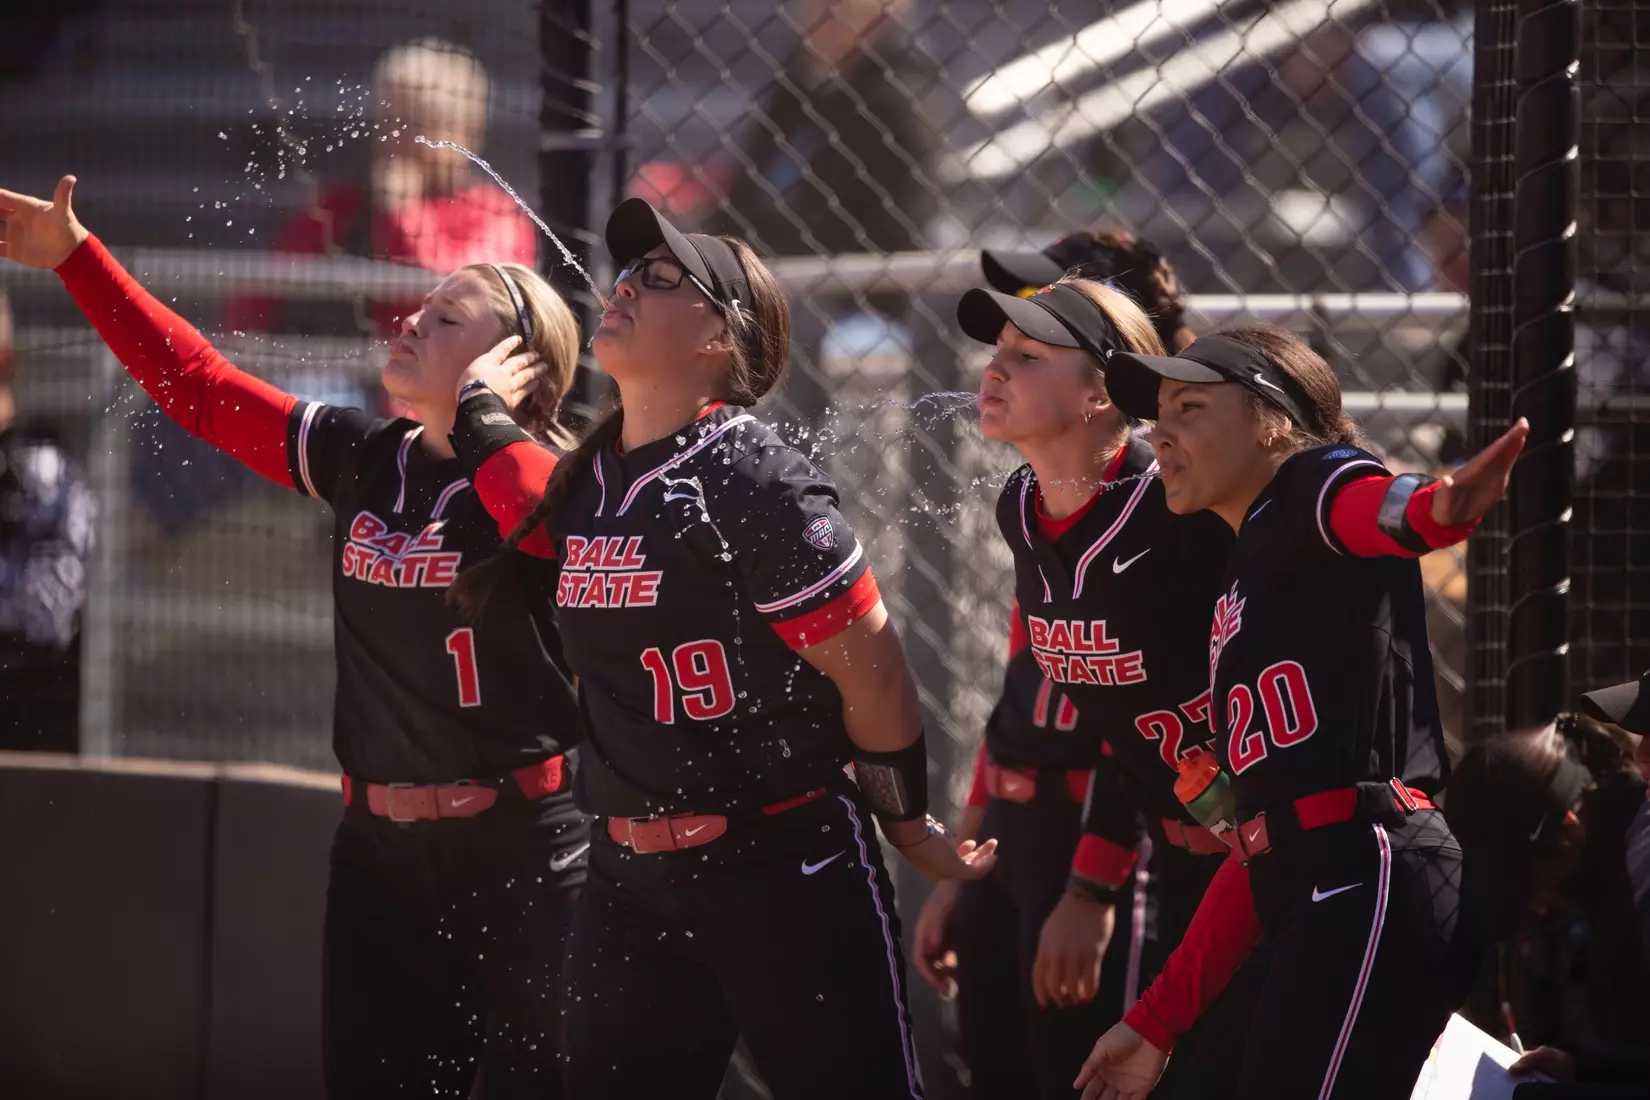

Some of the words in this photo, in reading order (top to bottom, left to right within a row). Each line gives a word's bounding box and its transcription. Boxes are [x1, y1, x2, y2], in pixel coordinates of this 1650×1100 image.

[343, 541, 463, 588] STATE
[562, 535, 647, 570] BALL
[556, 570, 664, 608] STATE
[1028, 614, 1119, 654] BALL
[446, 627, 481, 707] 1
[640, 638, 736, 724] 19
[1031, 649, 1147, 686] STATE
[1227, 660, 1319, 776] 20
